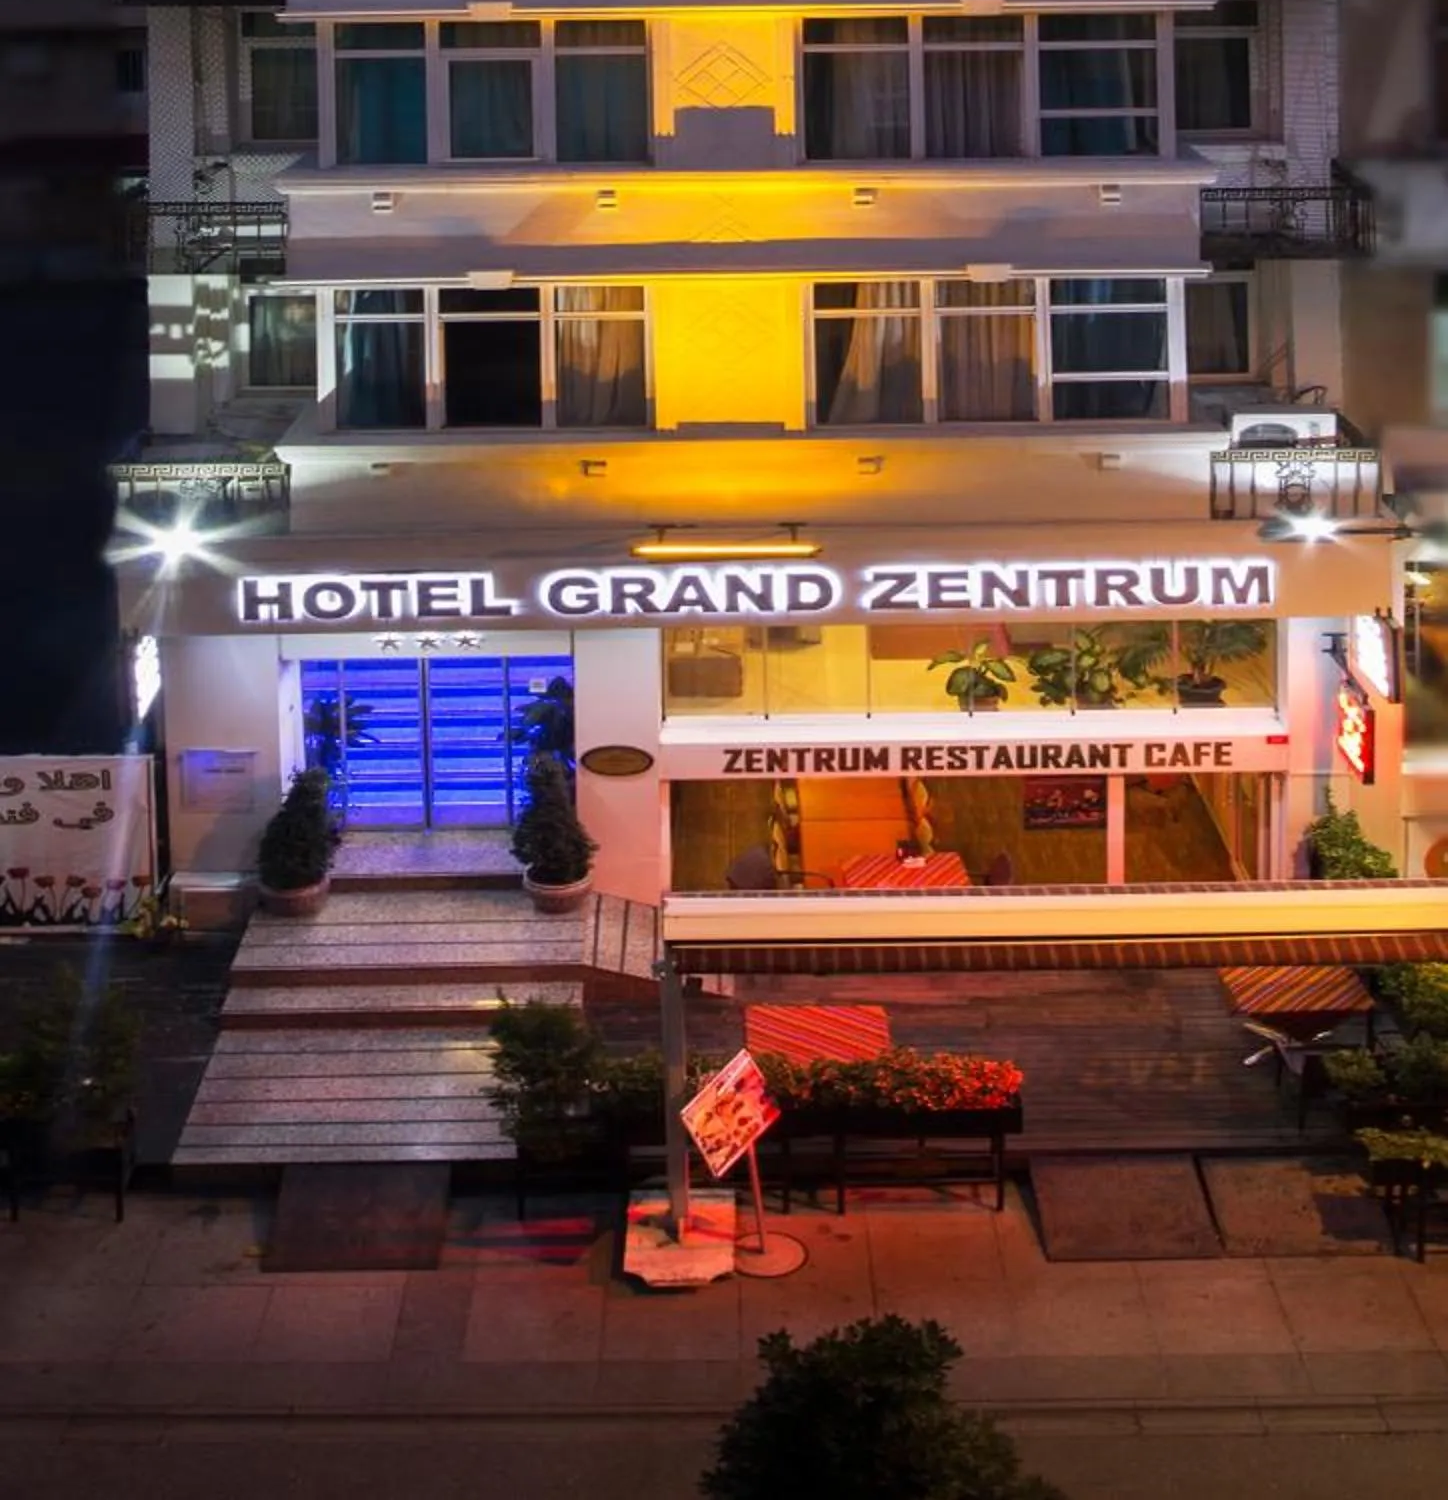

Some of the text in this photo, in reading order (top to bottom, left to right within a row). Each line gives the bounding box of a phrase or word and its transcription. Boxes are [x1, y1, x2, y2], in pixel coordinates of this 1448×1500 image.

[241, 565, 1272, 621] HOTEL GRAND ZENTRUM
[722, 741, 1233, 774] ZENTRUM RESTAURANT CAFE
